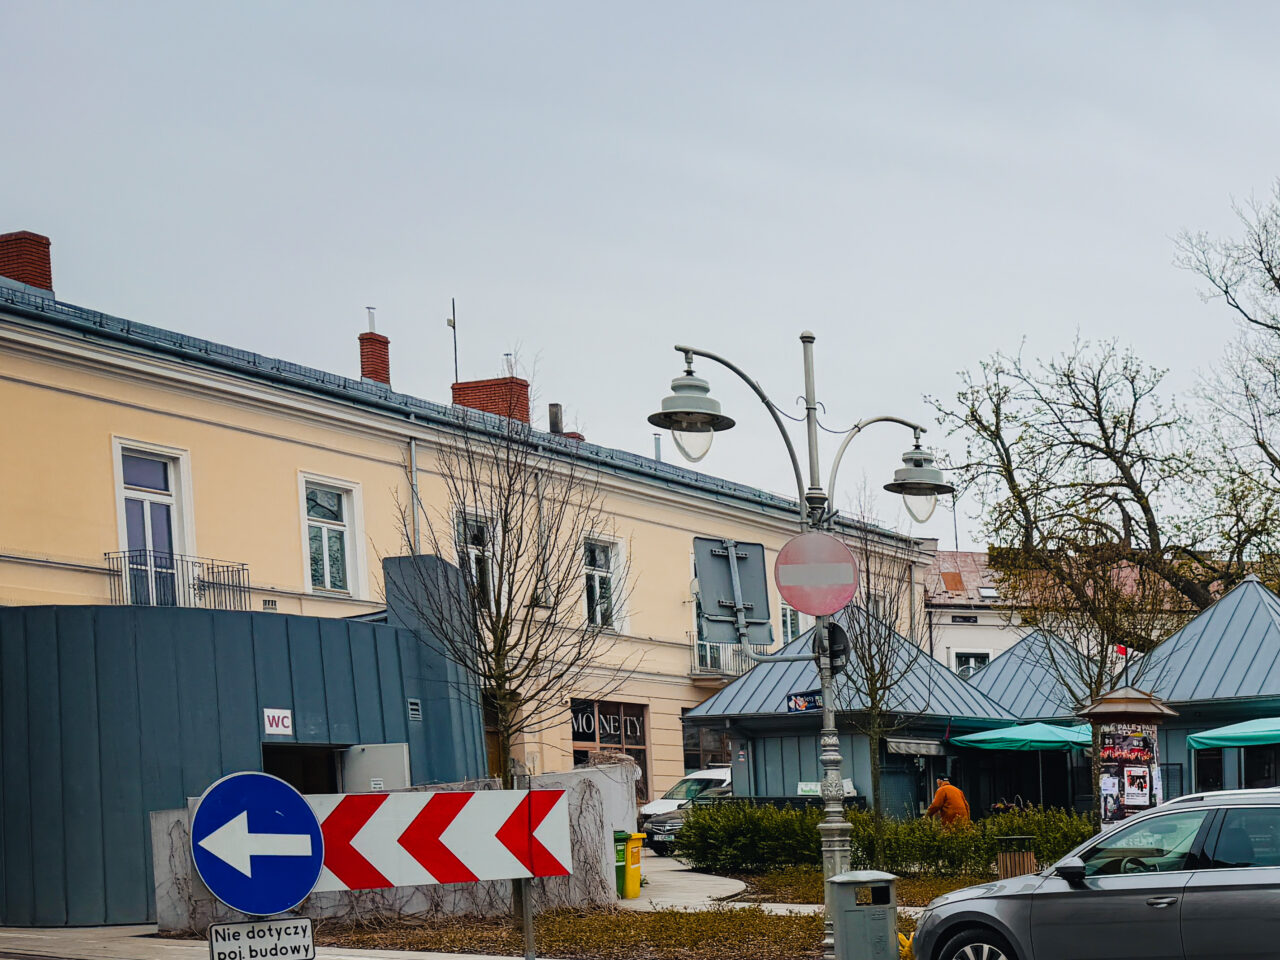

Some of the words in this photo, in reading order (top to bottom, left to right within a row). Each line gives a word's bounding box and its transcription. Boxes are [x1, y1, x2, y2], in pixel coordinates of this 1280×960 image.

[267, 715, 290, 729] WC
[572, 713, 643, 736] MONETY
[214, 927, 241, 943] Nie
[246, 924, 308, 942] dotyczy
[249, 943, 310, 959] budowy
